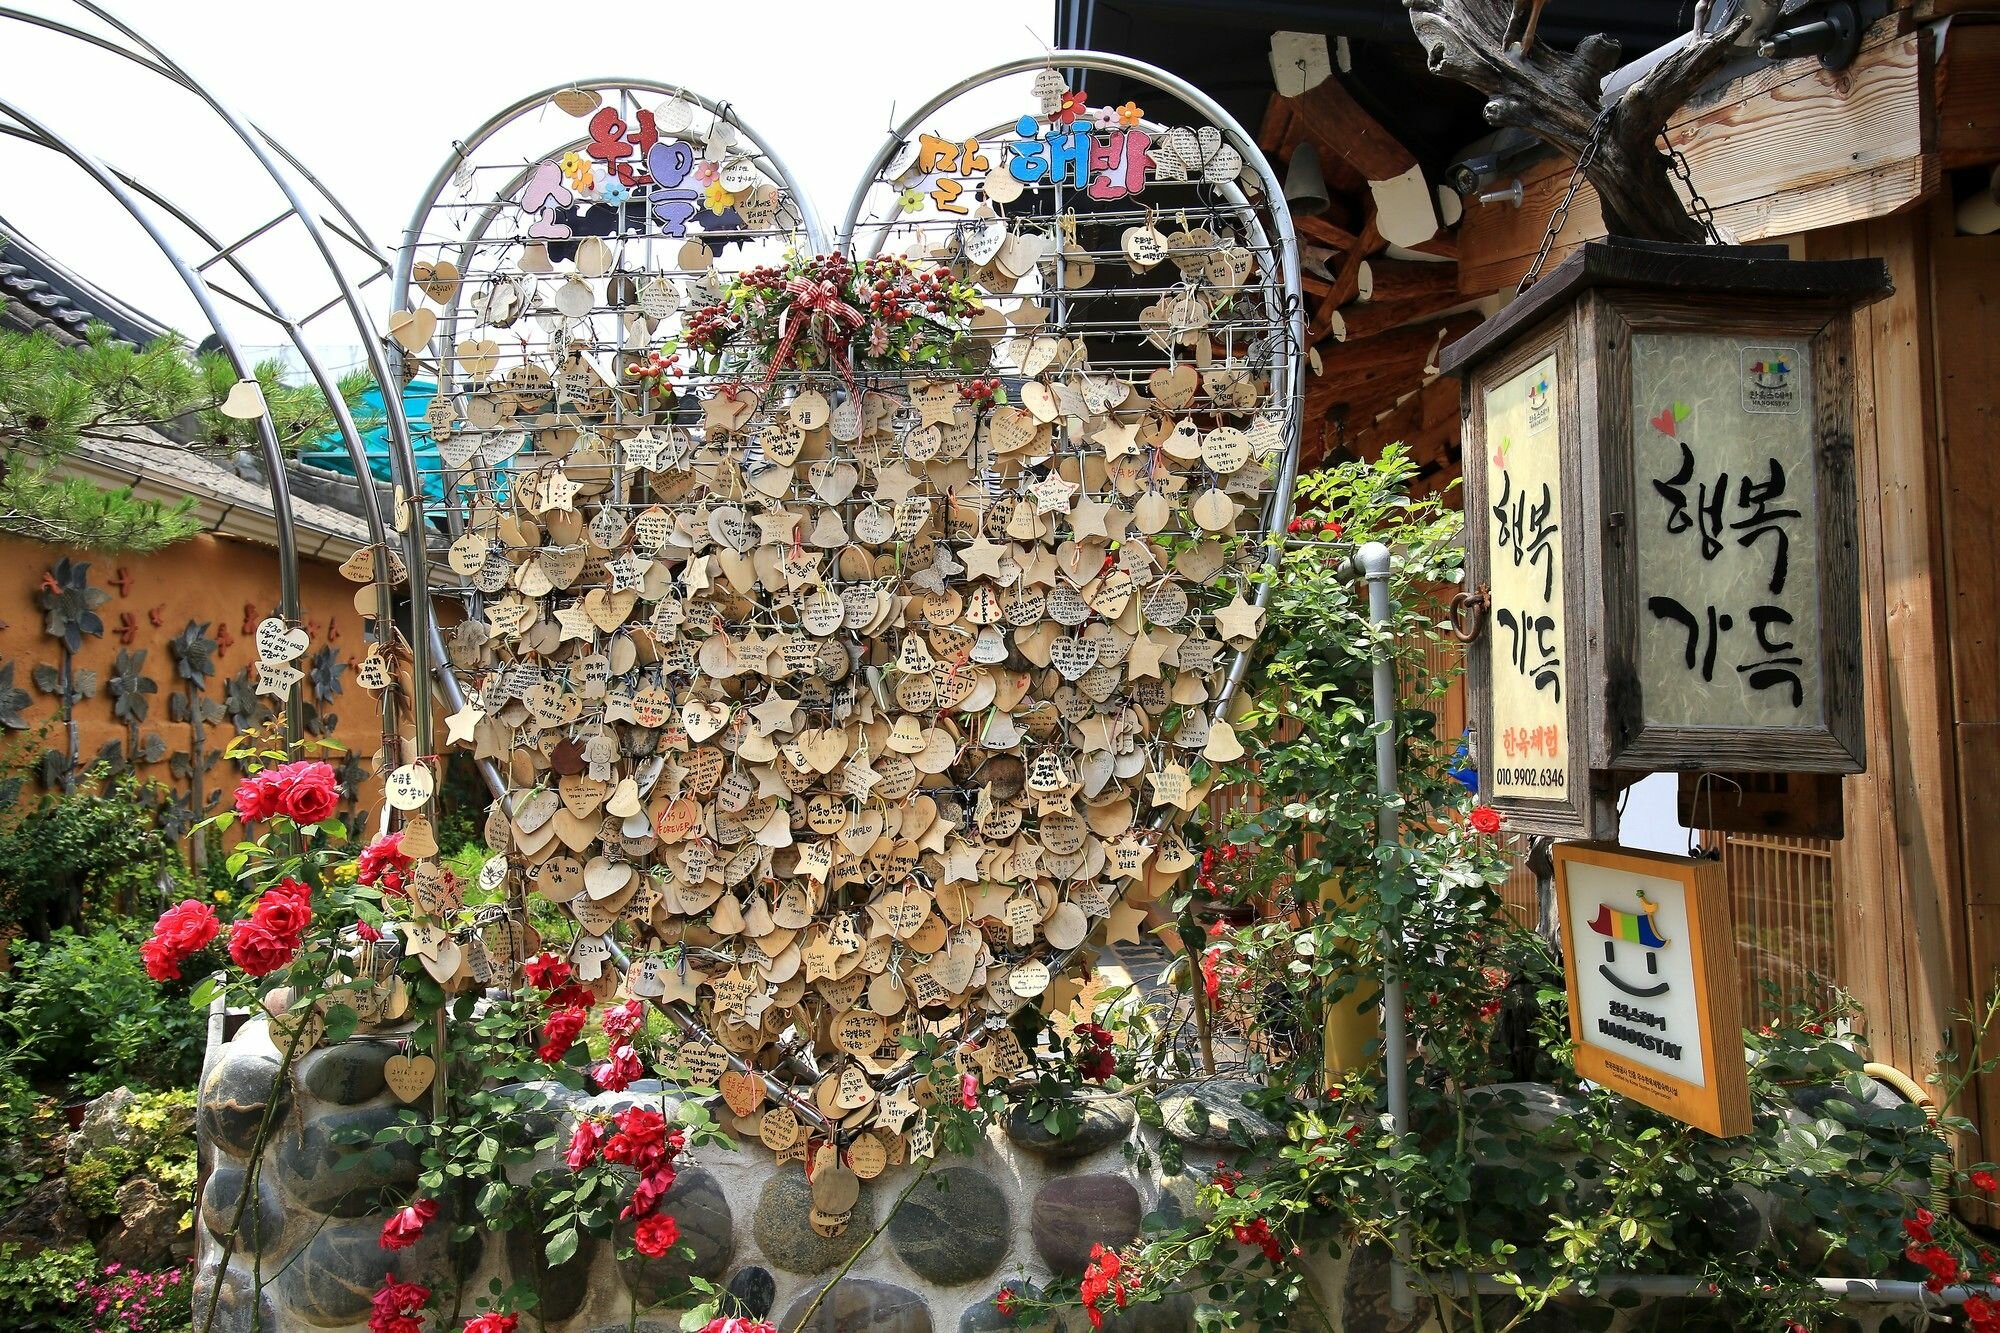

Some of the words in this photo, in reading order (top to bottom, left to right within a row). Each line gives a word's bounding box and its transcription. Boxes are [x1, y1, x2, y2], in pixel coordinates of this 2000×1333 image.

[1749, 390, 1793, 400] 한옥스테이
[799, 411, 811, 424] 福
[915, 448, 935, 458] 사랑해
[1653, 442, 1802, 594] 행복
[1493, 470, 1558, 602] 행복
[929, 608, 955, 621] 사랑해
[265, 621, 282, 634] 5/30
[1497, 607, 1560, 704] 가득
[1648, 596, 1803, 708] 가득
[1502, 724, 1559, 759] 한옥체험
[1496, 767, 1564, 787] 010.9902.6346
[679, 811, 686, 820] U
[658, 822, 690, 834] FOREVER
[1115, 848, 1140, 860] 행복하자
[1164, 850, 1181, 862] 가족
[579, 944, 597, 957] 은지
[846, 1017, 861, 1028] 가족
[861, 1016, 878, 1027] 건강
[1608, 1000, 1667, 1032] 한옥스테이
[1598, 1018, 1682, 1061] HANOKSTAY
